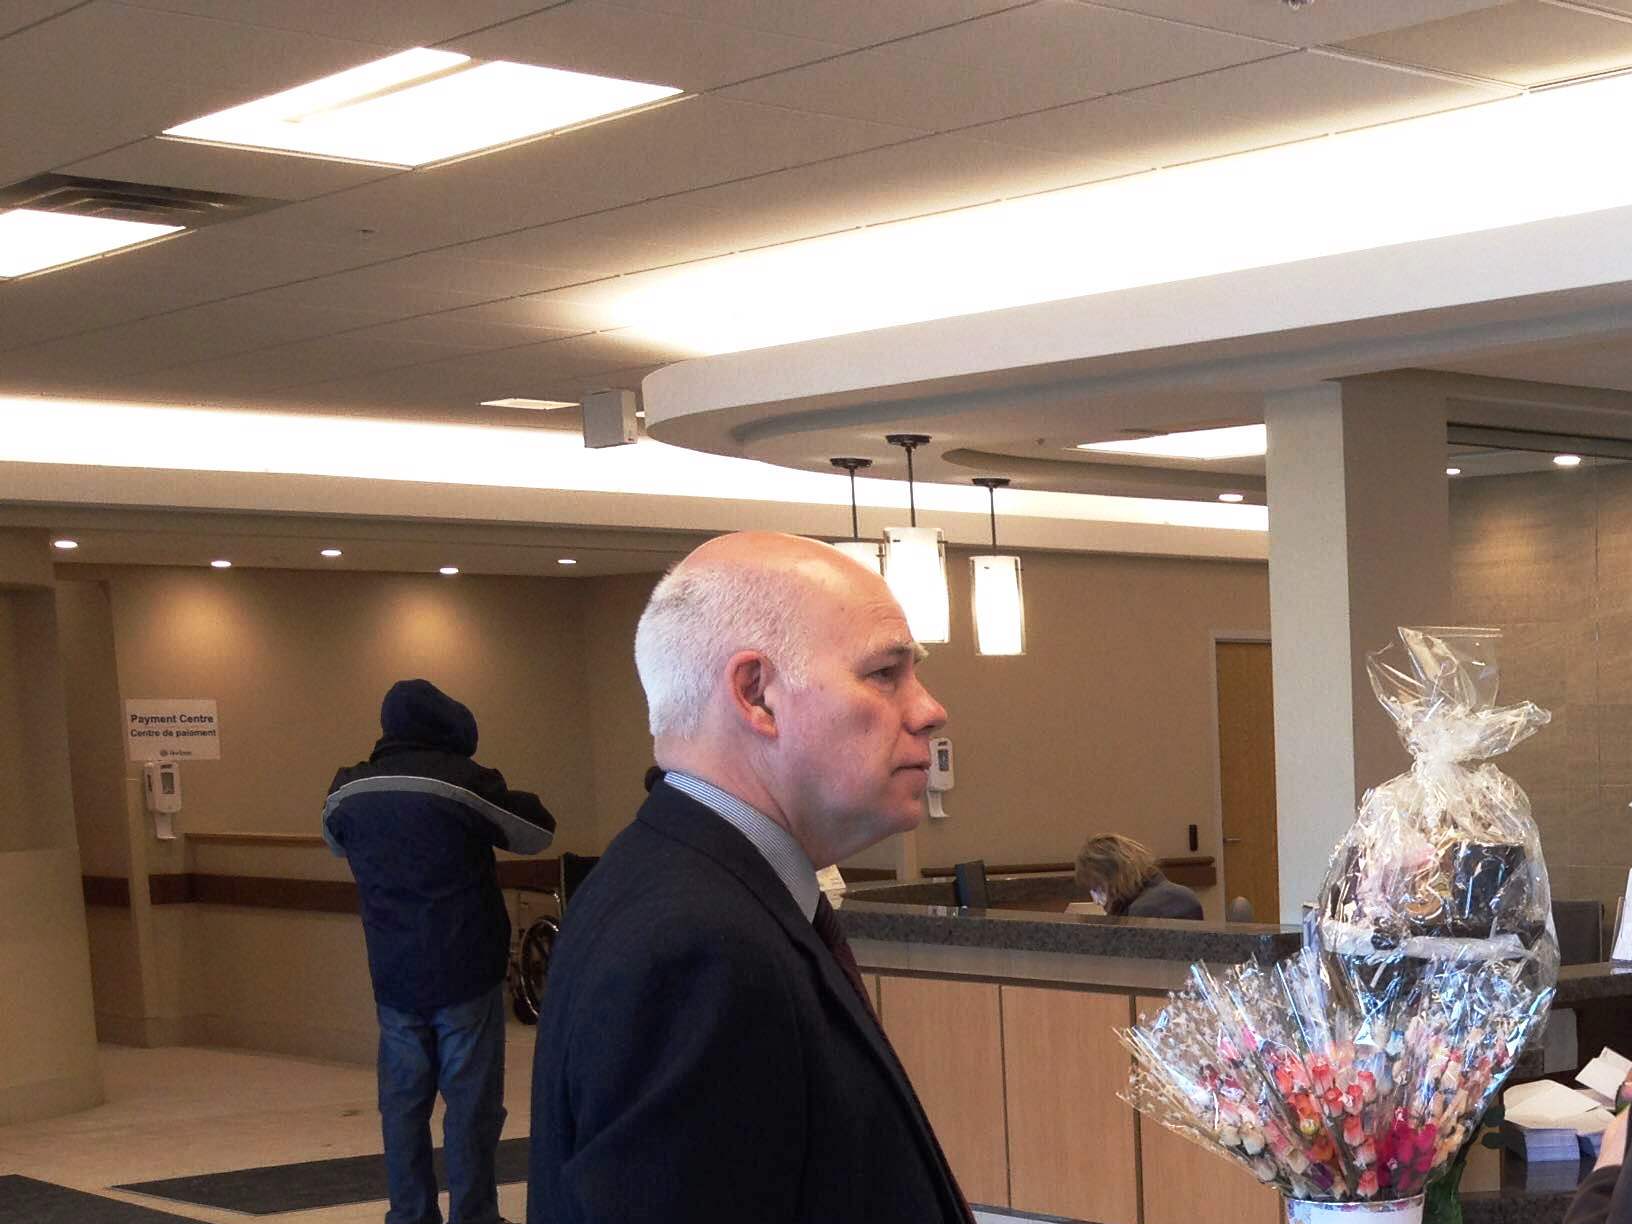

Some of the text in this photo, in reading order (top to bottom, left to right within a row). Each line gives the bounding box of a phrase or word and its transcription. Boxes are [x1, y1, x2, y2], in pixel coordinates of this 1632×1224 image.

[130, 714, 214, 726] Payment Centre
[130, 729, 160, 738] Centre
[162, 729, 174, 738] de
